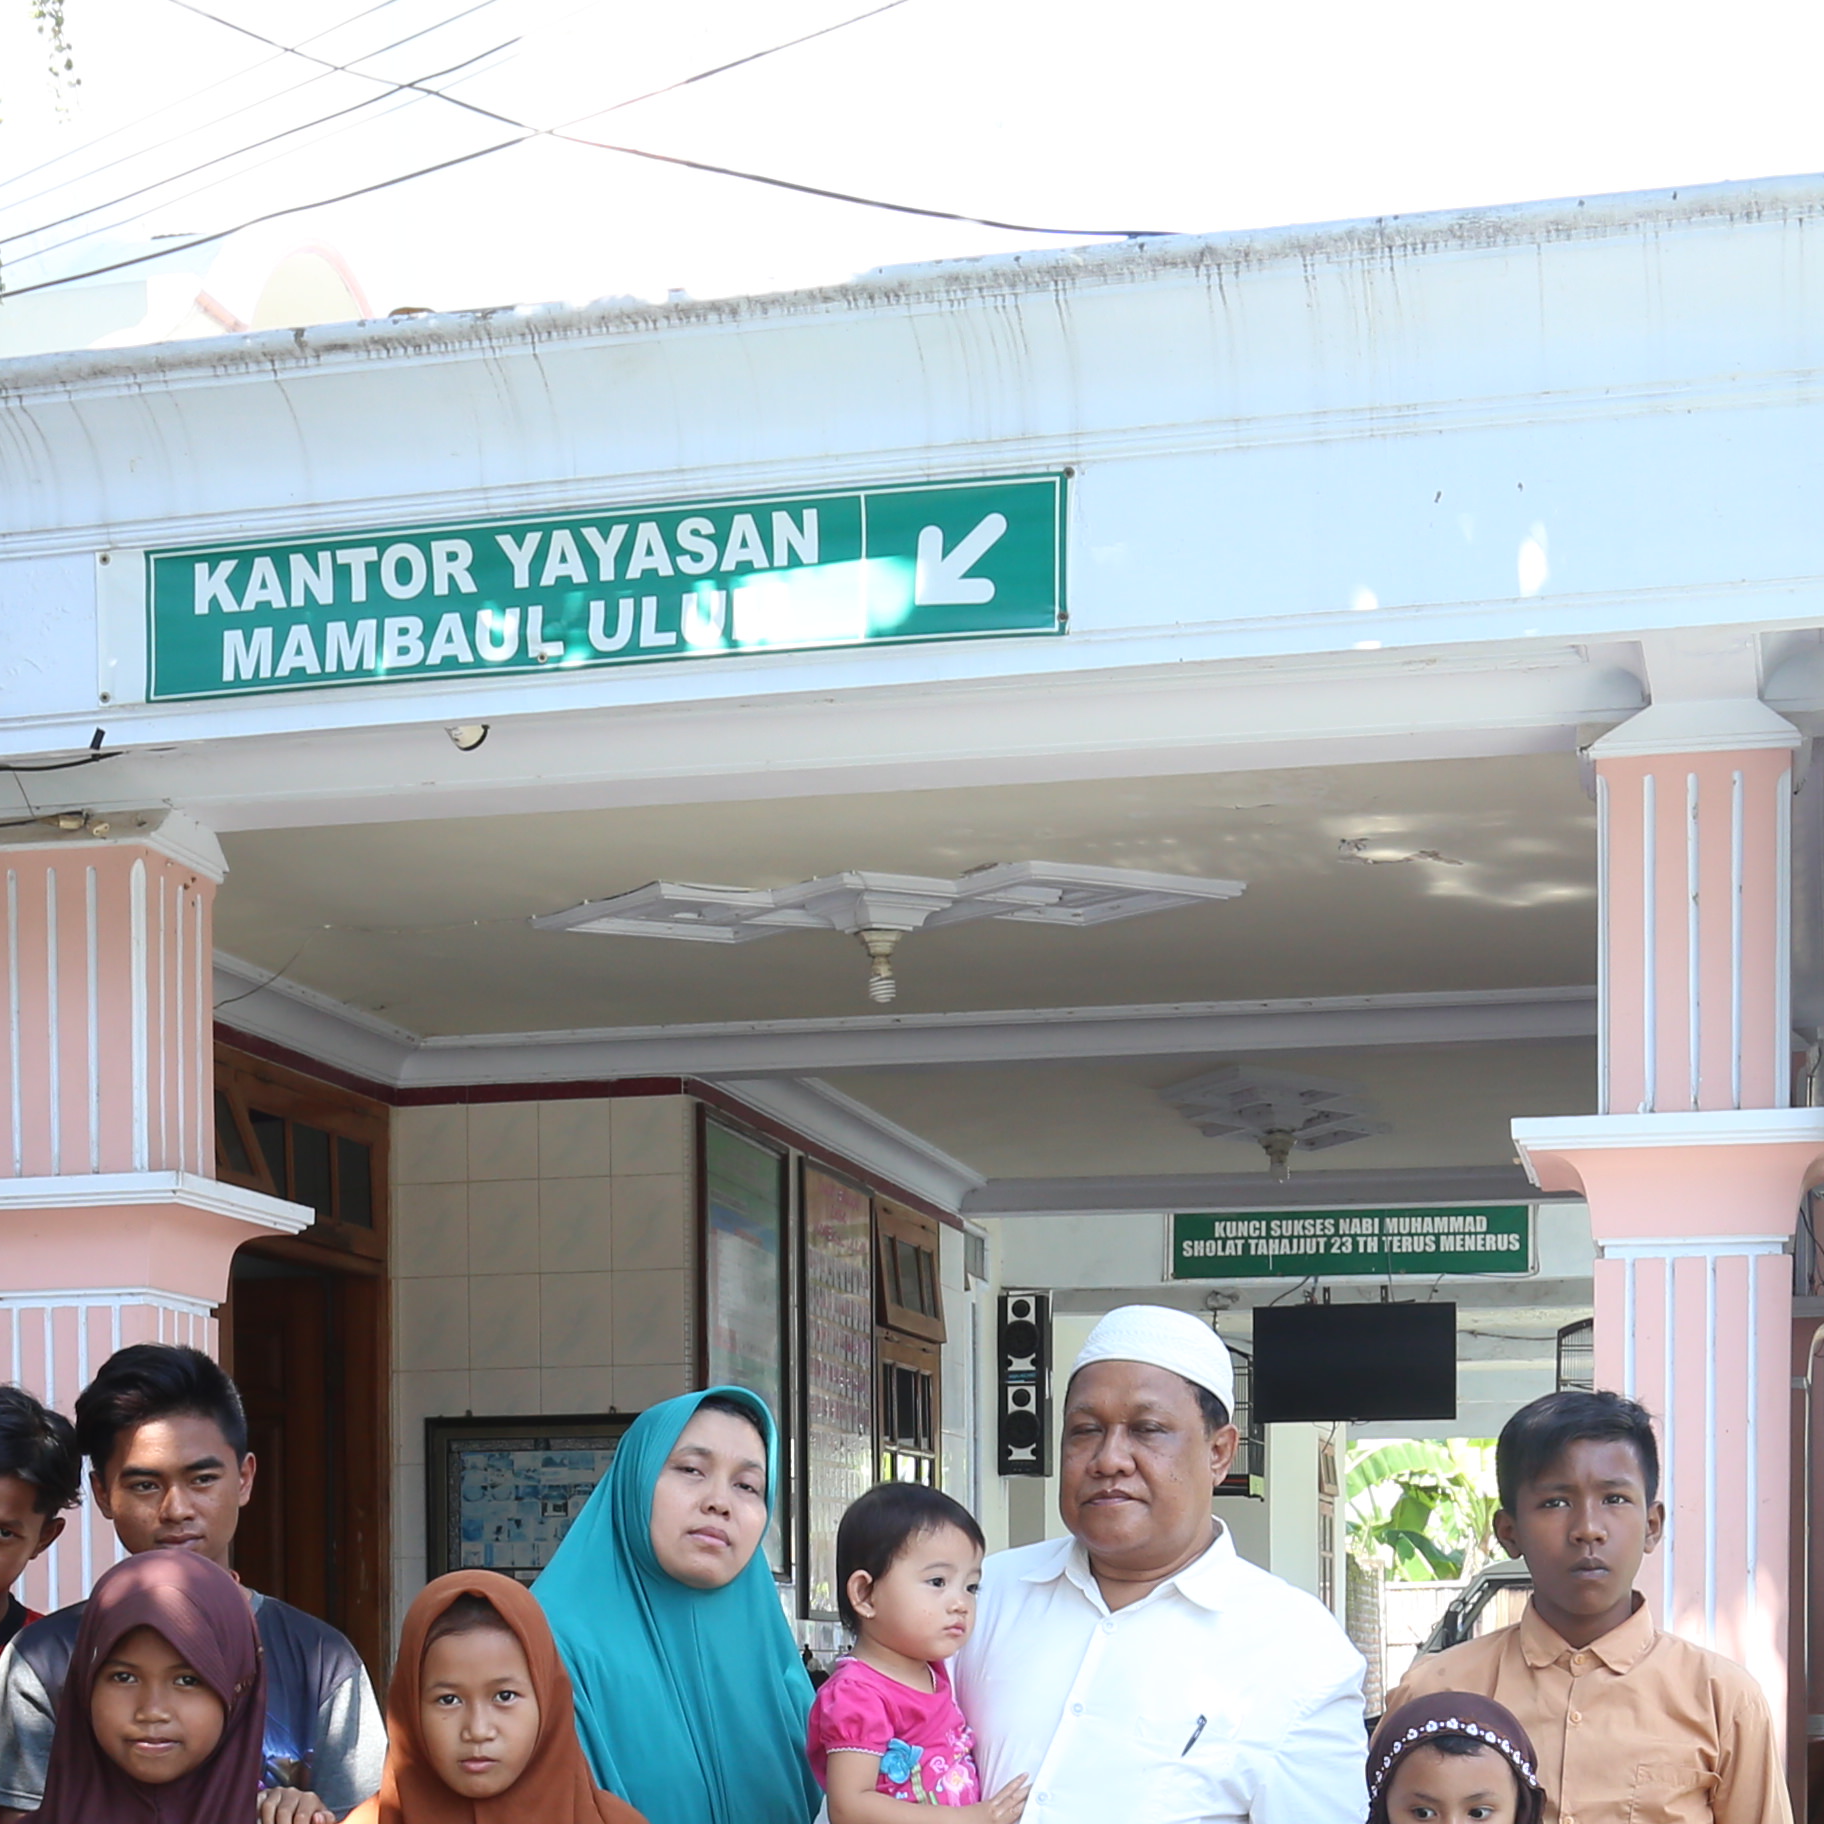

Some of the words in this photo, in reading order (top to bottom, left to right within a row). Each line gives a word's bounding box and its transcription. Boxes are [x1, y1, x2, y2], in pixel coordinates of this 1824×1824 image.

[194, 538, 478, 615] KANTOR
[495, 508, 819, 589] YAYASAN
[222, 604, 564, 682] MAMBAUL
[588, 588, 756, 652] ULU
[1182, 1239, 1245, 1257] SHOLAT
[1248, 1237, 1327, 1256] TAHAJJUT
[1330, 1236, 1353, 1253] 23
[1356, 1236, 1379, 1253] TH
[1382, 1235, 1436, 1252] TERUS
[1439, 1233, 1520, 1252] MENERUS
[1214, 1220, 1267, 1238] KUNCI
[1270, 1219, 1335, 1237] SUKSES
[1339, 1217, 1380, 1235] NABI
[1384, 1215, 1488, 1234] MUHAMMAD
